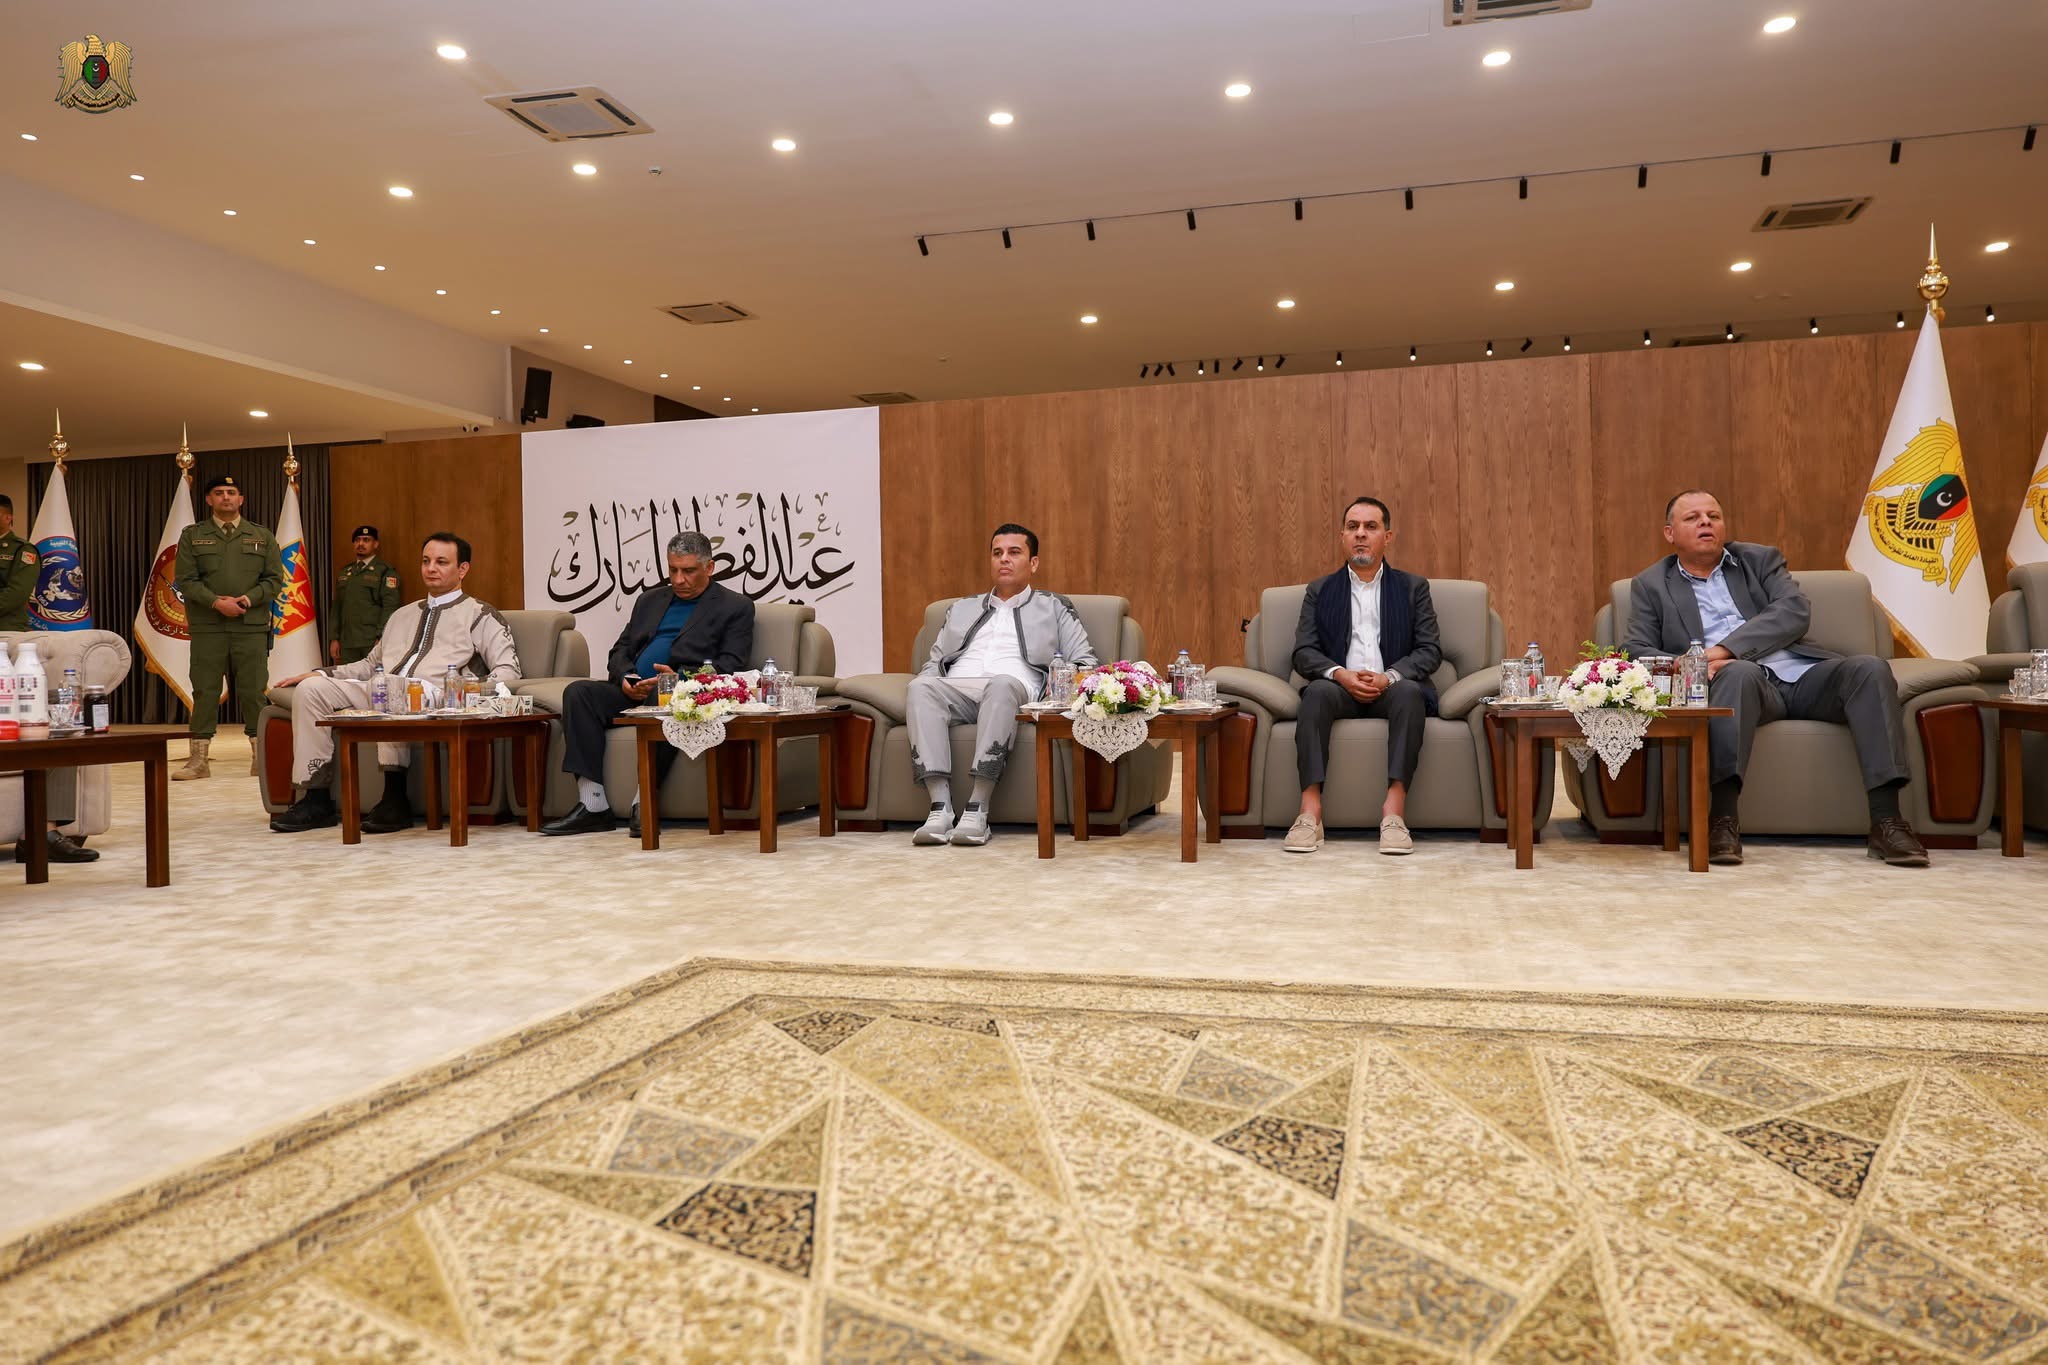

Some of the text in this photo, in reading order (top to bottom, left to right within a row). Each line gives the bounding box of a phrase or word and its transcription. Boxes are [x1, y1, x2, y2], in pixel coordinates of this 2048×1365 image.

[547, 492, 855, 614] عيد الفط البارك
